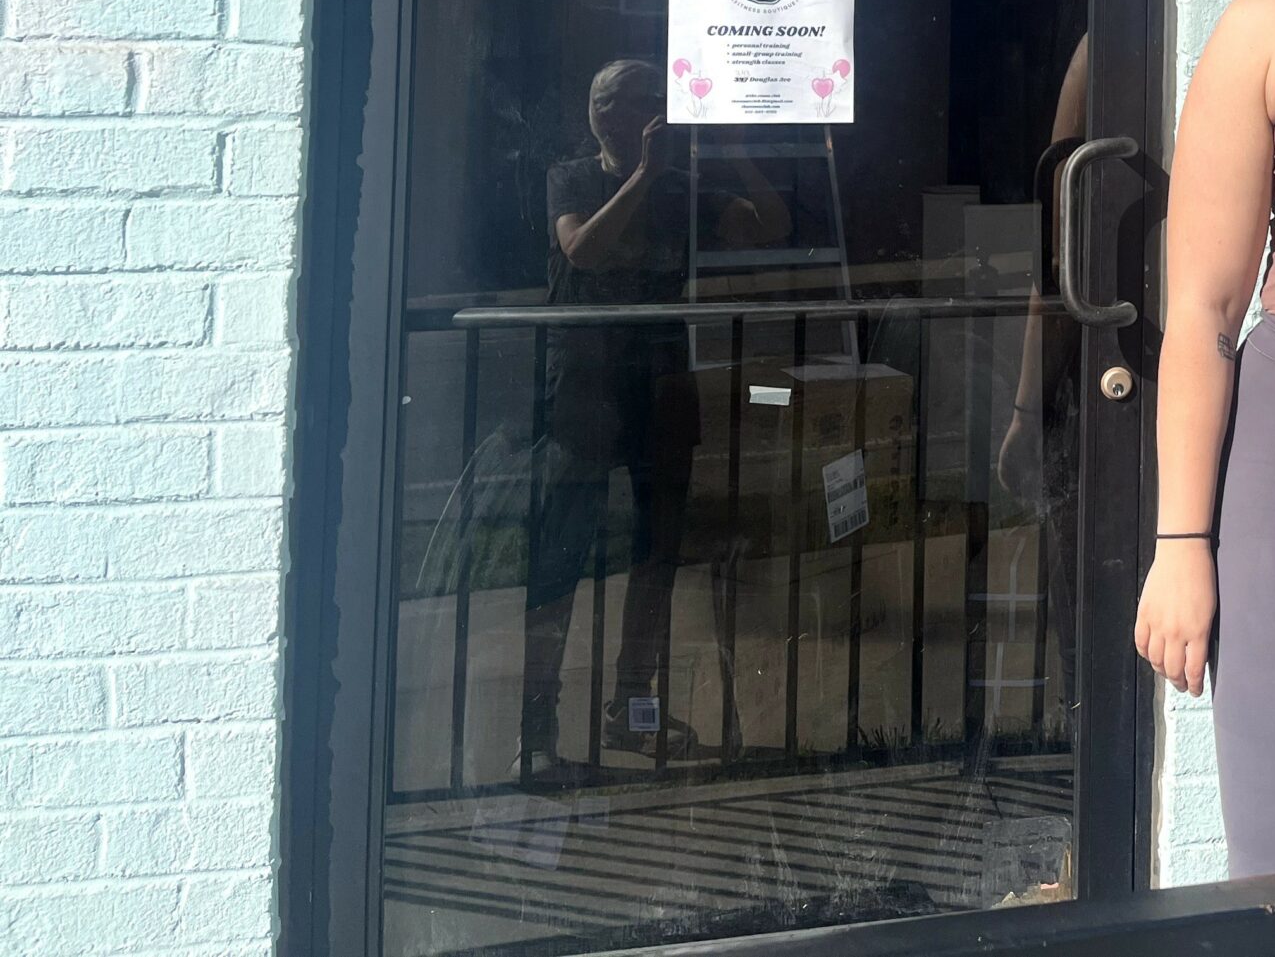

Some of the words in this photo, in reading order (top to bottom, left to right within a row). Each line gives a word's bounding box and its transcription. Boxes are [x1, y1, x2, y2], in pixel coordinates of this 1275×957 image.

[734, 0, 760, 14] FITNESS
[763, 0, 796, 14] BOUTIQUE
[707, 25, 774, 37] COMING
[775, 25, 825, 37] SOON!
